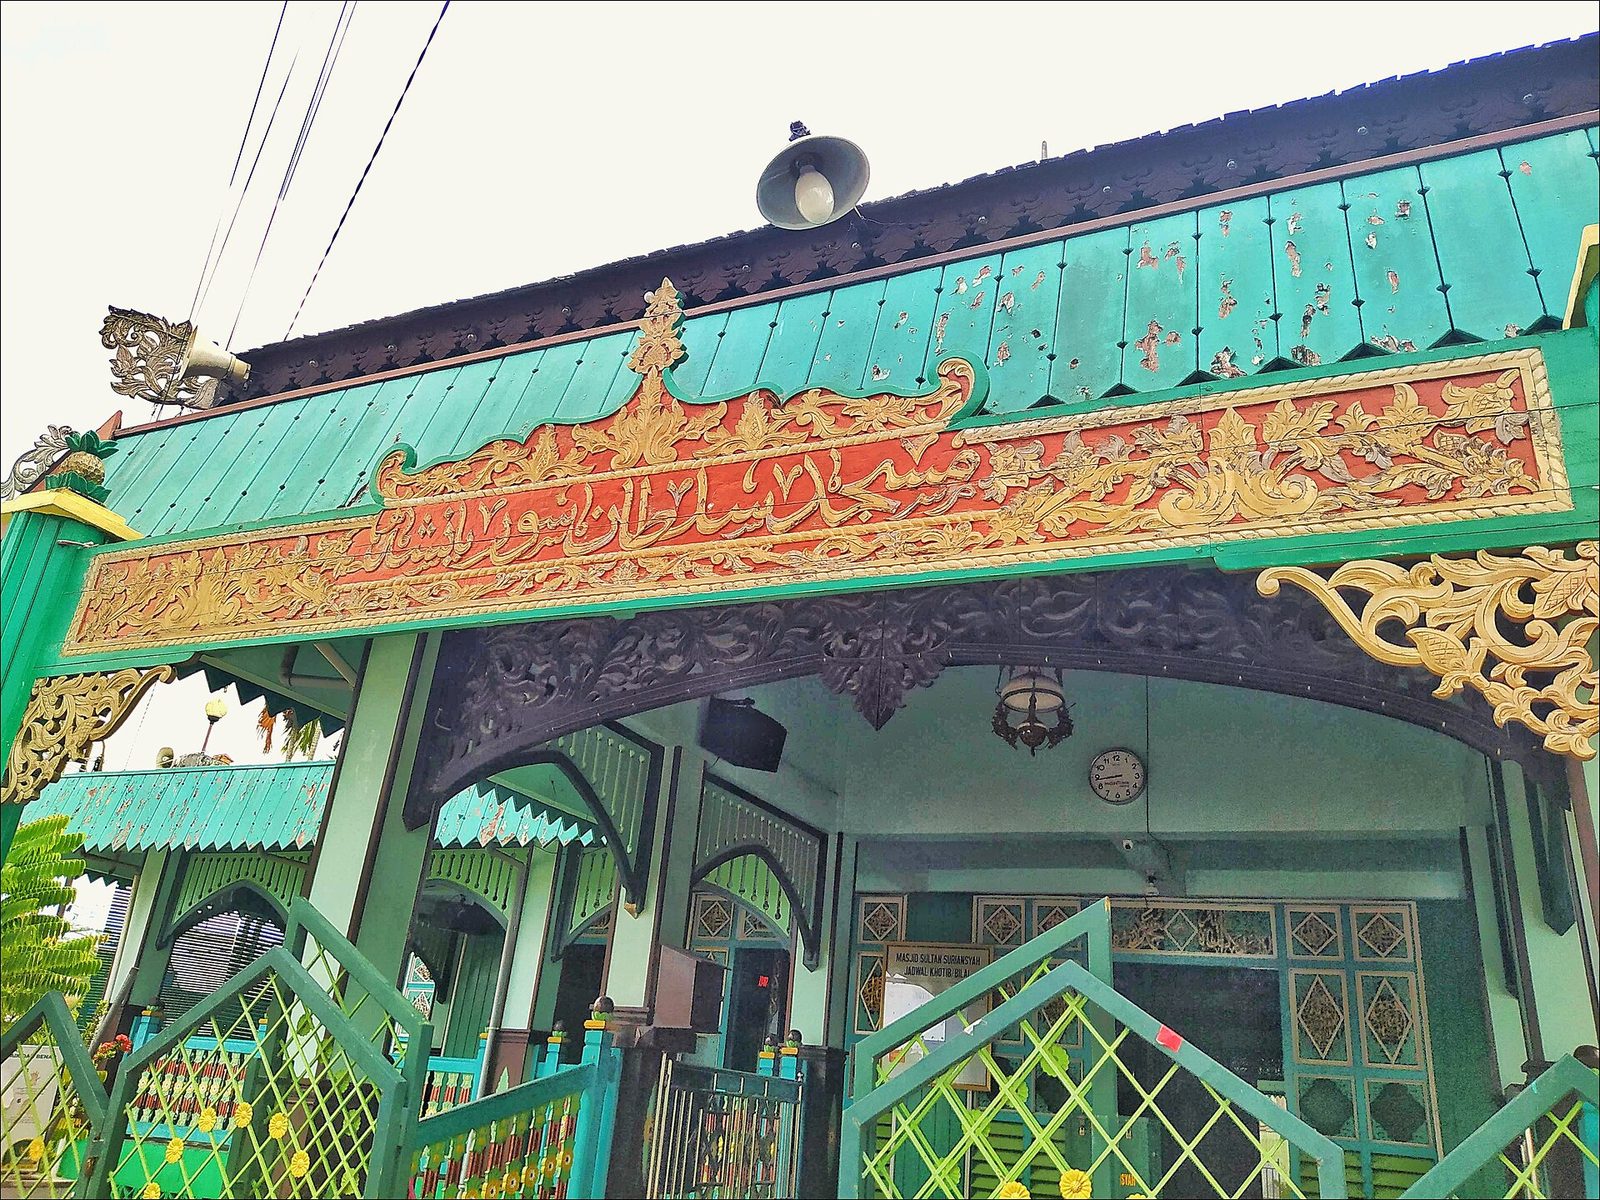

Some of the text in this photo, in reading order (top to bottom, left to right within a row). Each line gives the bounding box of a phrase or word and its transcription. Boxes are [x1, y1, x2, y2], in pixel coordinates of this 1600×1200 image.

[896, 953, 981, 966] MASJID SULTAN SURIANSYAH
[904, 966, 928, 976] JADWAL
